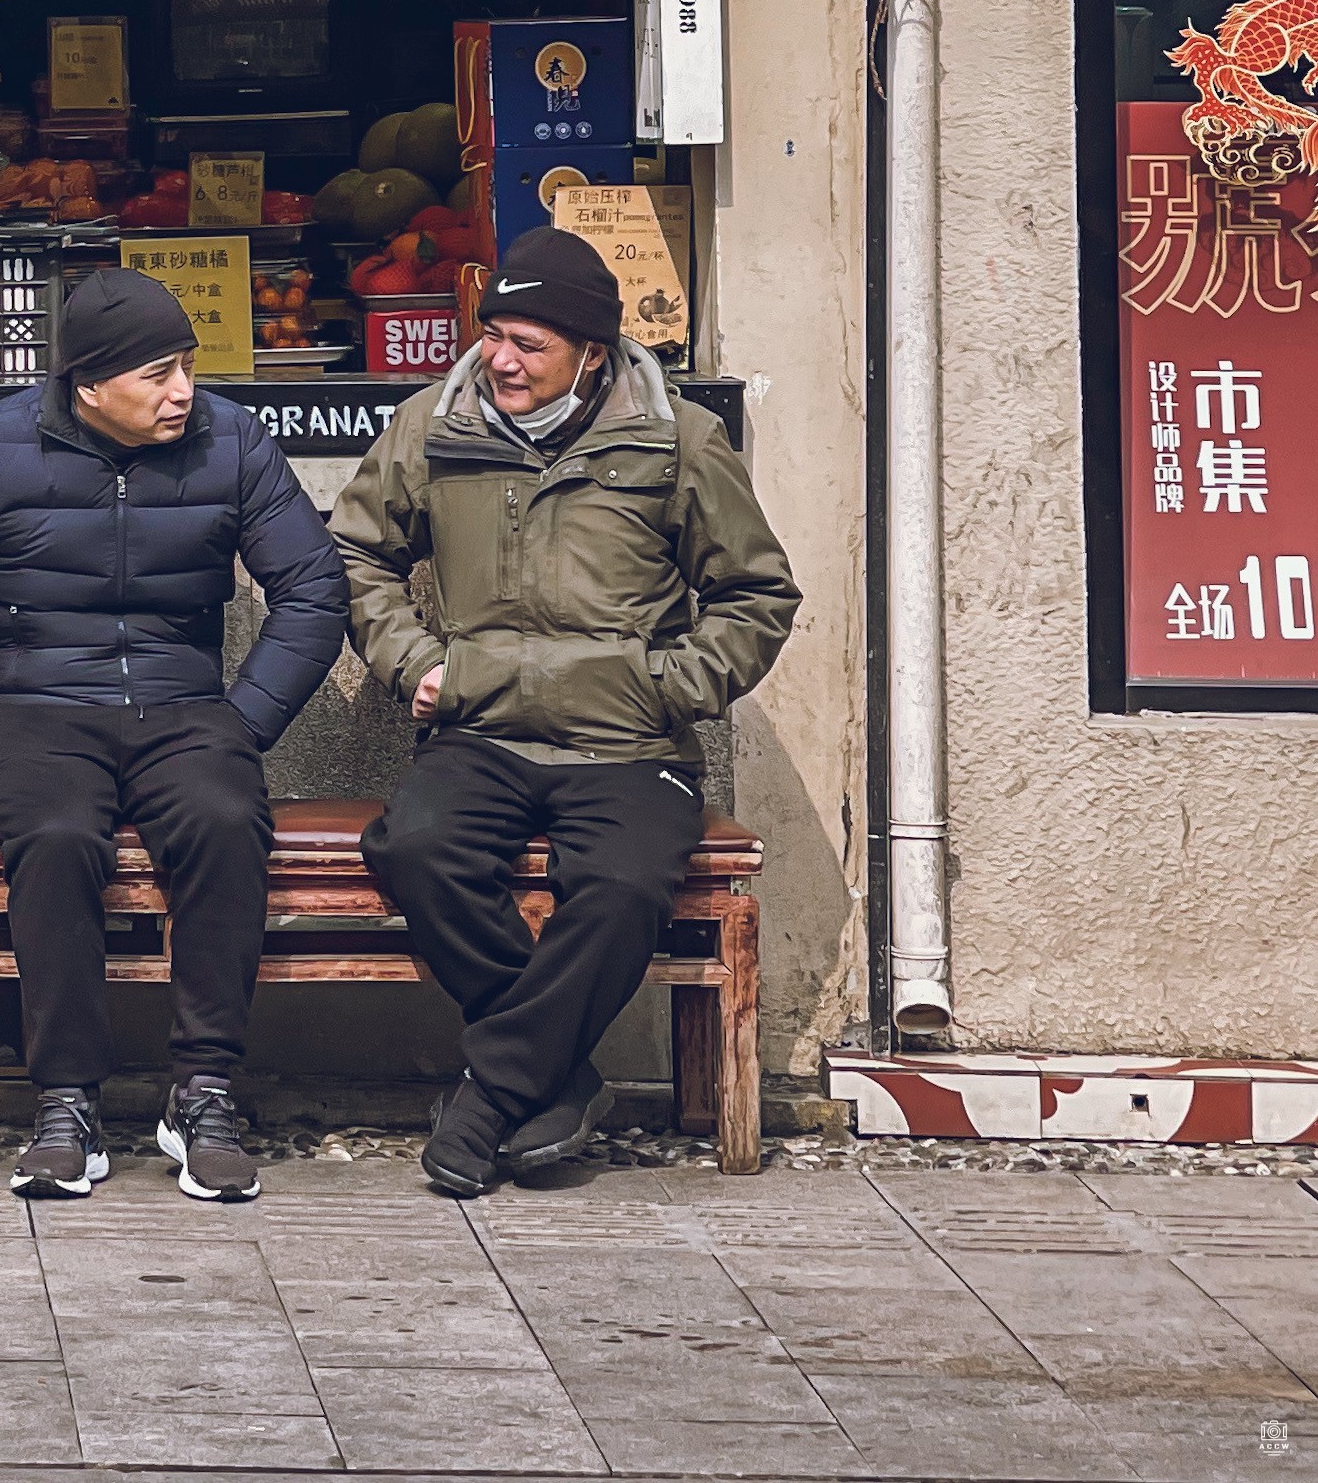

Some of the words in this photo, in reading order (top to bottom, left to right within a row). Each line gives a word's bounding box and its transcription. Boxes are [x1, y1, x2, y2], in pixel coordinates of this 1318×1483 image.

[575, 208, 623, 223] 石榴汁
[250, 404, 394, 437] GRANAT
[1147, 360, 1184, 513] 设计师品牌
[1190, 360, 1268, 513] 市集
